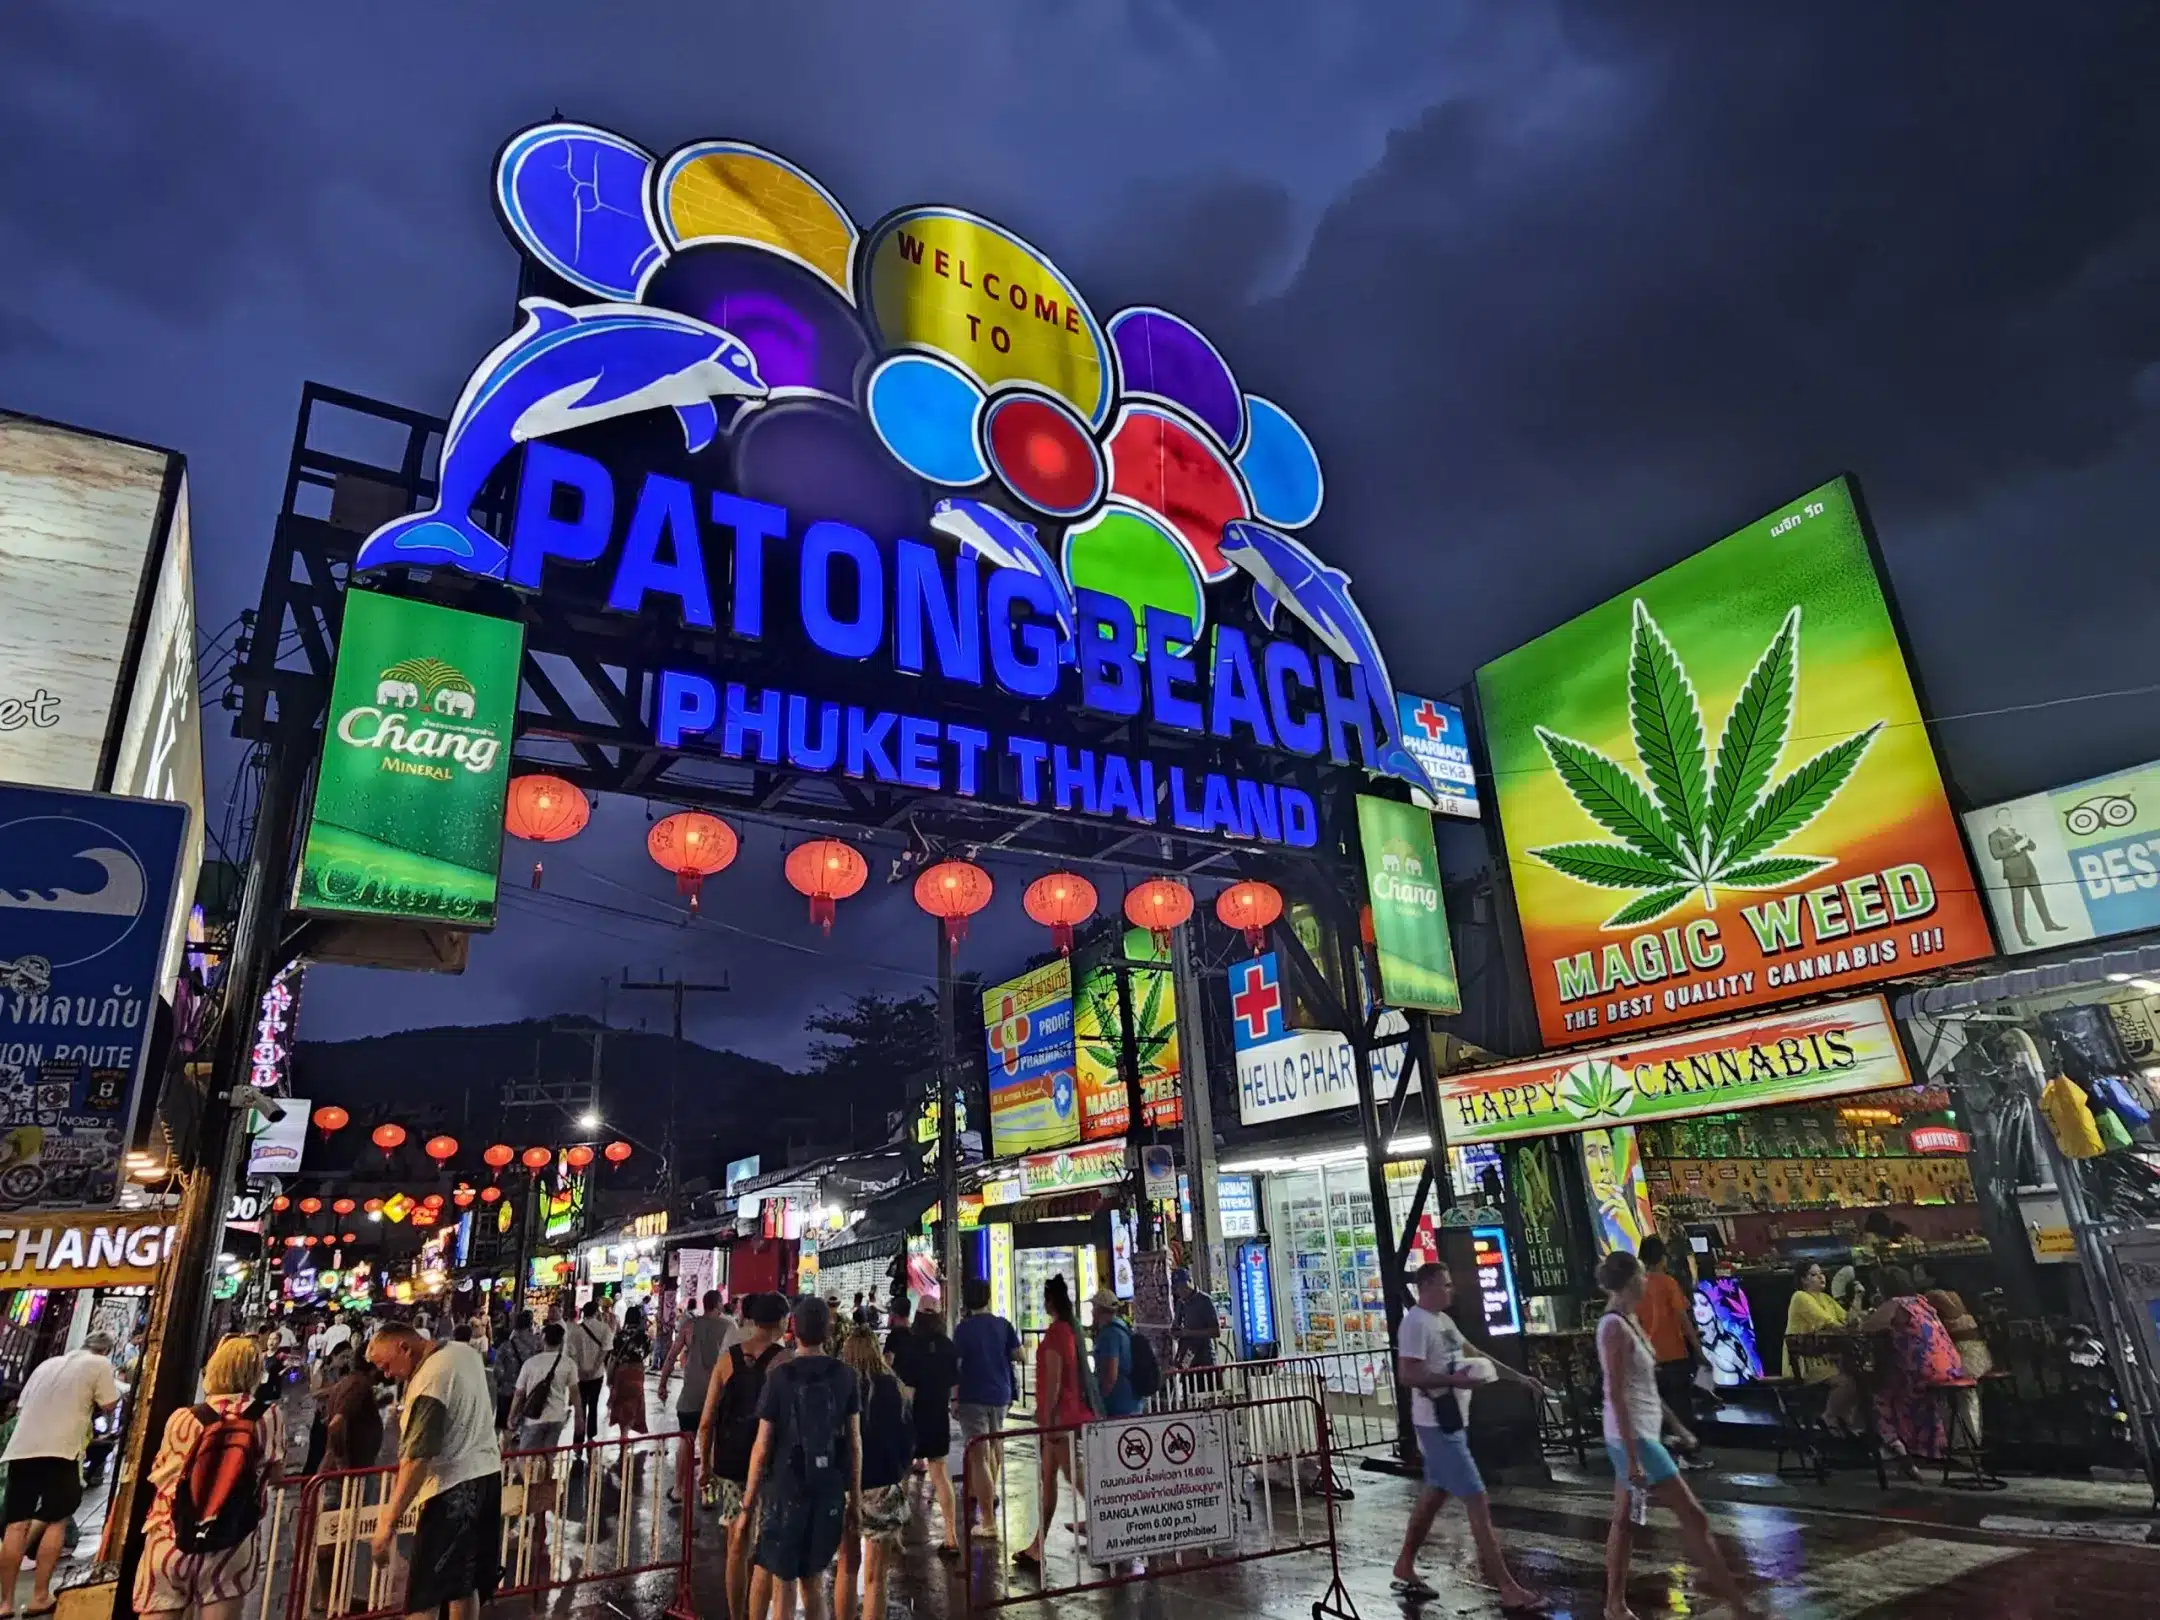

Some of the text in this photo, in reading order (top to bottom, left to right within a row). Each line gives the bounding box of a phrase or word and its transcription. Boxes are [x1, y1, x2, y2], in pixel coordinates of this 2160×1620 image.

[897, 230, 1081, 335] WELCOME
[966, 313, 1011, 354] TO
[508, 441, 1380, 768] PATONG BEACH
[337, 706, 502, 773] Chang
[1402, 735, 1468, 763] PHARMACY
[658, 668, 1320, 848] PHUKET THAILAND
[1373, 872, 1438, 912] Chang
[1552, 862, 1938, 1003] MAGIC WEED
[1563, 1011, 1599, 1033] THE
[1606, 996, 1655, 1024] BEST
[1663, 971, 1756, 1012] QUALITY
[1767, 938, 1898, 988] CANNABIS
[1039, 1011, 1071, 1037] PROOF
[0, 1043, 134, 1068] ION ROUTE
[1242, 1041, 1409, 1109] HELLO PHARAC
[1456, 1028, 1860, 1127] HAPPY CANNABIS
[1914, 1132, 1960, 1150] SMIRNOFF
[1217, 1181, 1251, 1197] ARMACY
[1524, 1226, 1551, 1245] GET
[1529, 1247, 1564, 1266] HIGH
[1532, 1269, 1569, 1288] NOW!
[1251, 1270, 1270, 1341] PHARMACY
[1099, 1495, 1220, 1521] BANGLA WALKING STREET
[1126, 1513, 1197, 1534] (From 6.00 p.m.)
[1106, 1524, 1217, 1550] All vehicles are prohibited
